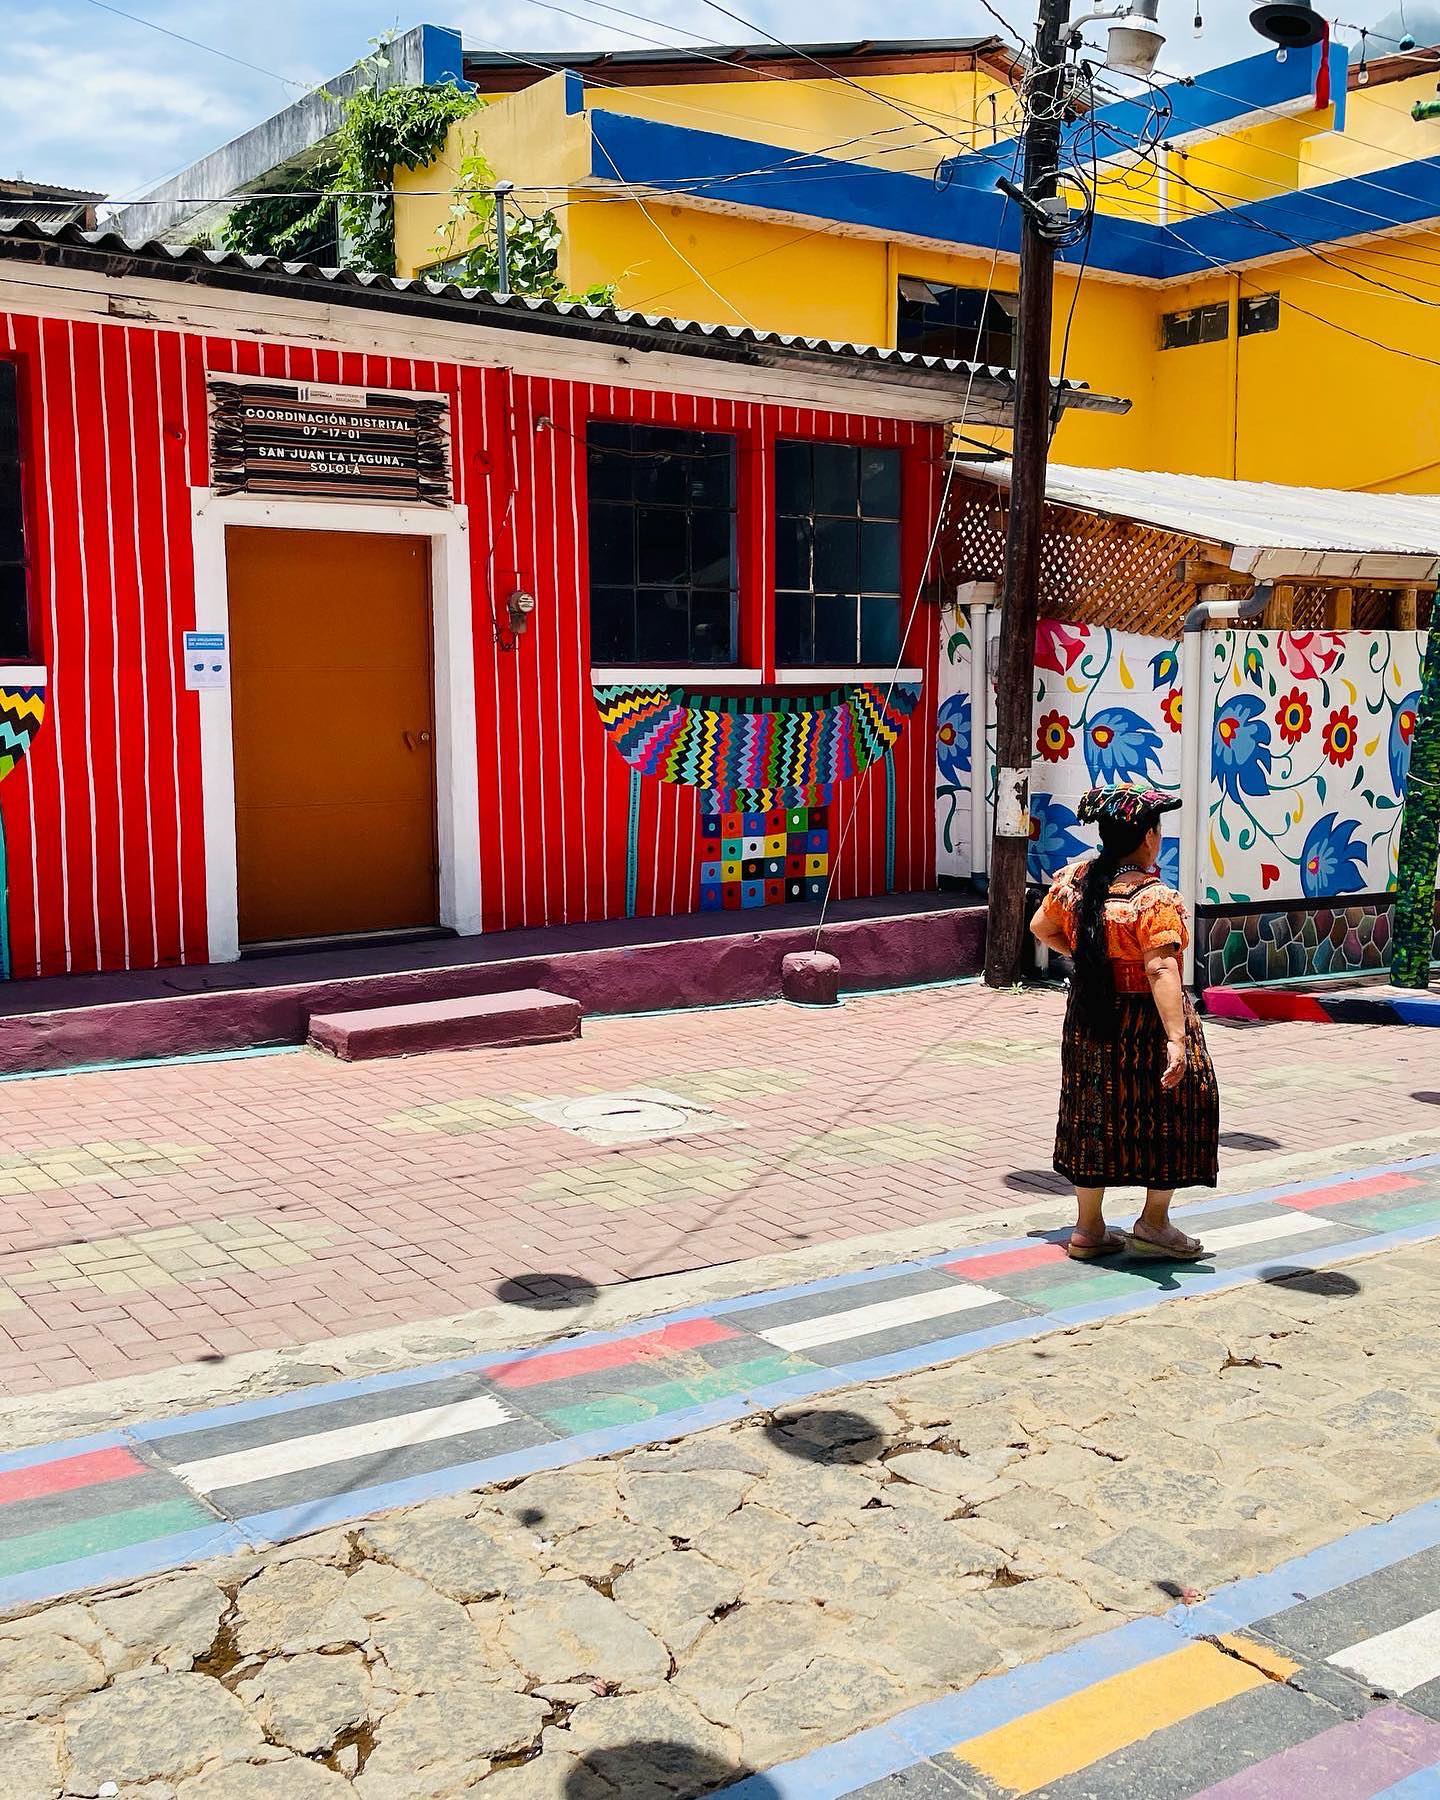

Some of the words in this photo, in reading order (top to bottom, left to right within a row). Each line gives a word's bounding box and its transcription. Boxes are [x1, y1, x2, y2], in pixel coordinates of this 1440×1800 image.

[245, 408, 347, 426] COORDINACIÓN
[351, 417, 411, 431] DISTRITAL
[258, 446, 285, 458] SAN
[290, 449, 325, 461] JUAN
[329, 451, 346, 462] LA
[350, 453, 405, 467] LAGUNA,
[310, 462, 361, 475] SOLOLÁ
